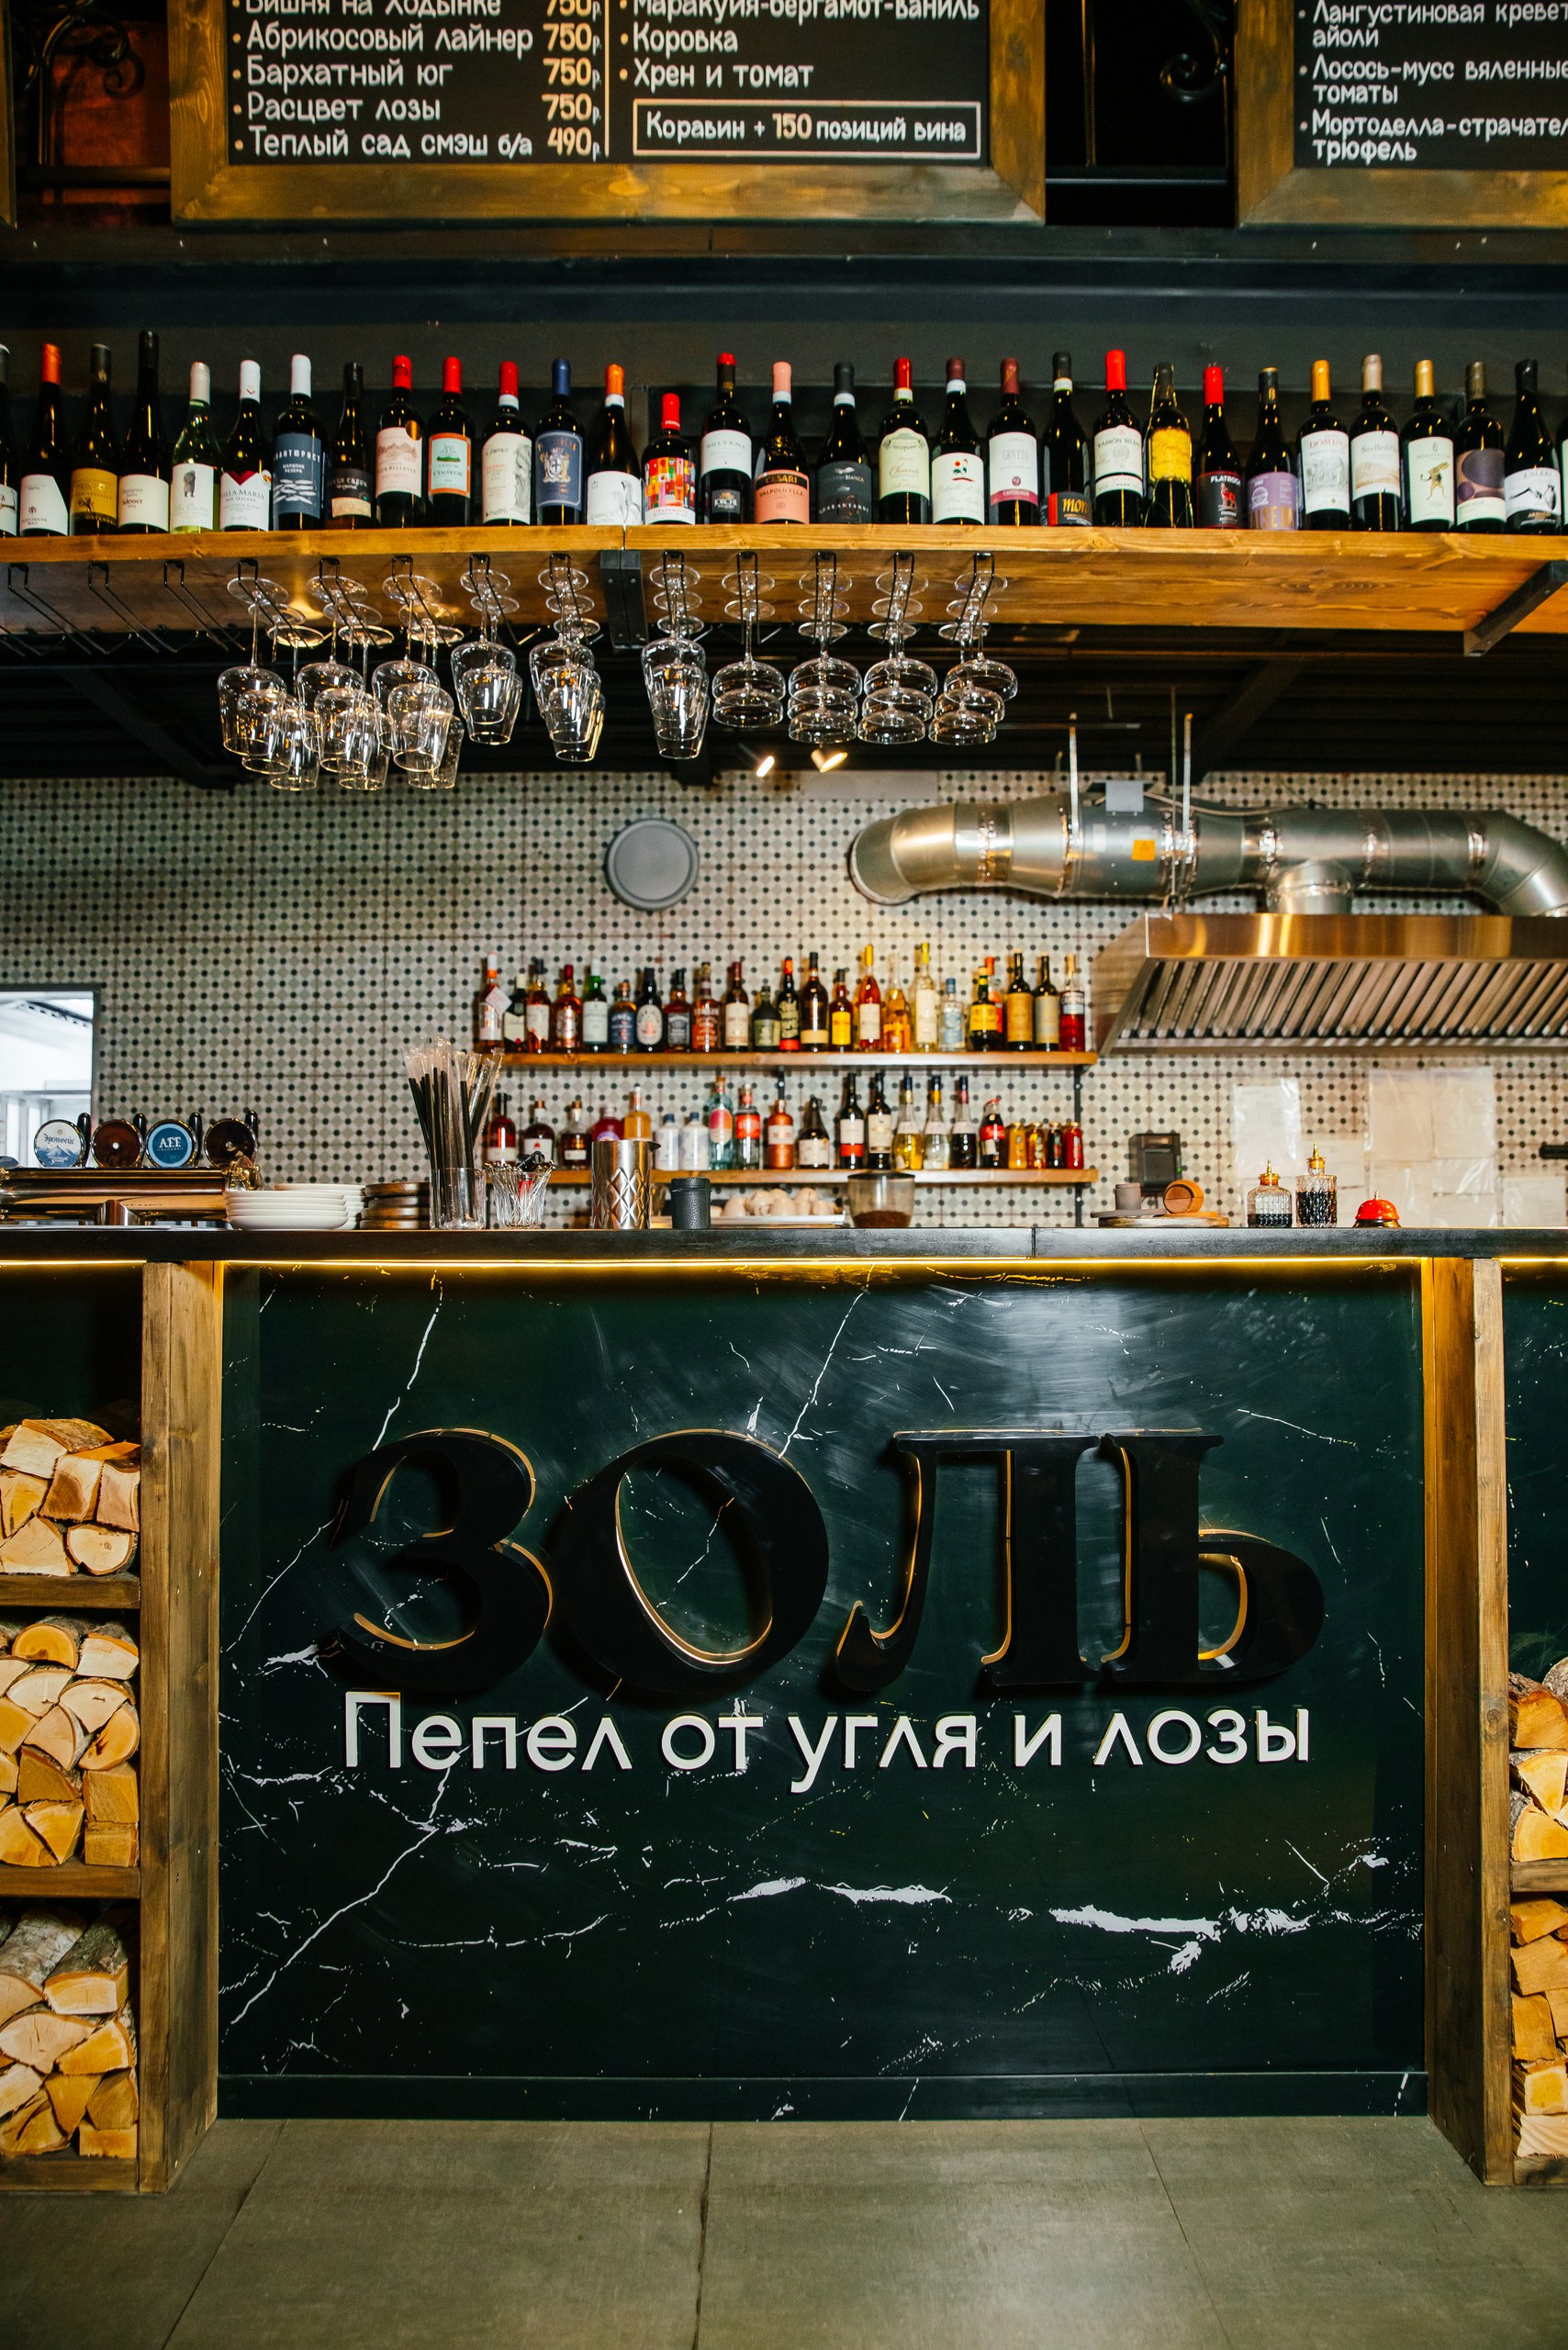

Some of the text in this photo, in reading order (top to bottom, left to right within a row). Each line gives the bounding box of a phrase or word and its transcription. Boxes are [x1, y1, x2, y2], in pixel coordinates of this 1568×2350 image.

[342, 0, 375, 15] на
[1314, 0, 1484, 28] Лангустиновая
[247, 20, 423, 58] Абрикосовый
[434, 24, 533, 60] лайнер
[633, 21, 738, 59] Коровка
[1313, 27, 1379, 48] айоли
[247, 55, 403, 94] Бархатный
[417, 63, 454, 86] юг
[634, 58, 814, 93] Хрен и томат
[1313, 53, 1568, 86] Лосось-мусс вяленные
[248, 92, 364, 123] Расцвет
[375, 98, 441, 121] лозы
[1313, 84, 1398, 105] томаты
[249, 125, 349, 157] Теплый
[362, 133, 411, 158] сад
[420, 132, 488, 157] смэш
[498, 133, 532, 160] б/а
[646, 111, 967, 144] Коравин + 150 позиций вина
[1313, 139, 1417, 166] трюфель
[765, 474, 798, 484] CESARI
[330, 1428, 1324, 1693] ЗОЛЬ
[345, 1692, 1310, 1793] Пепел от угля и лозы
